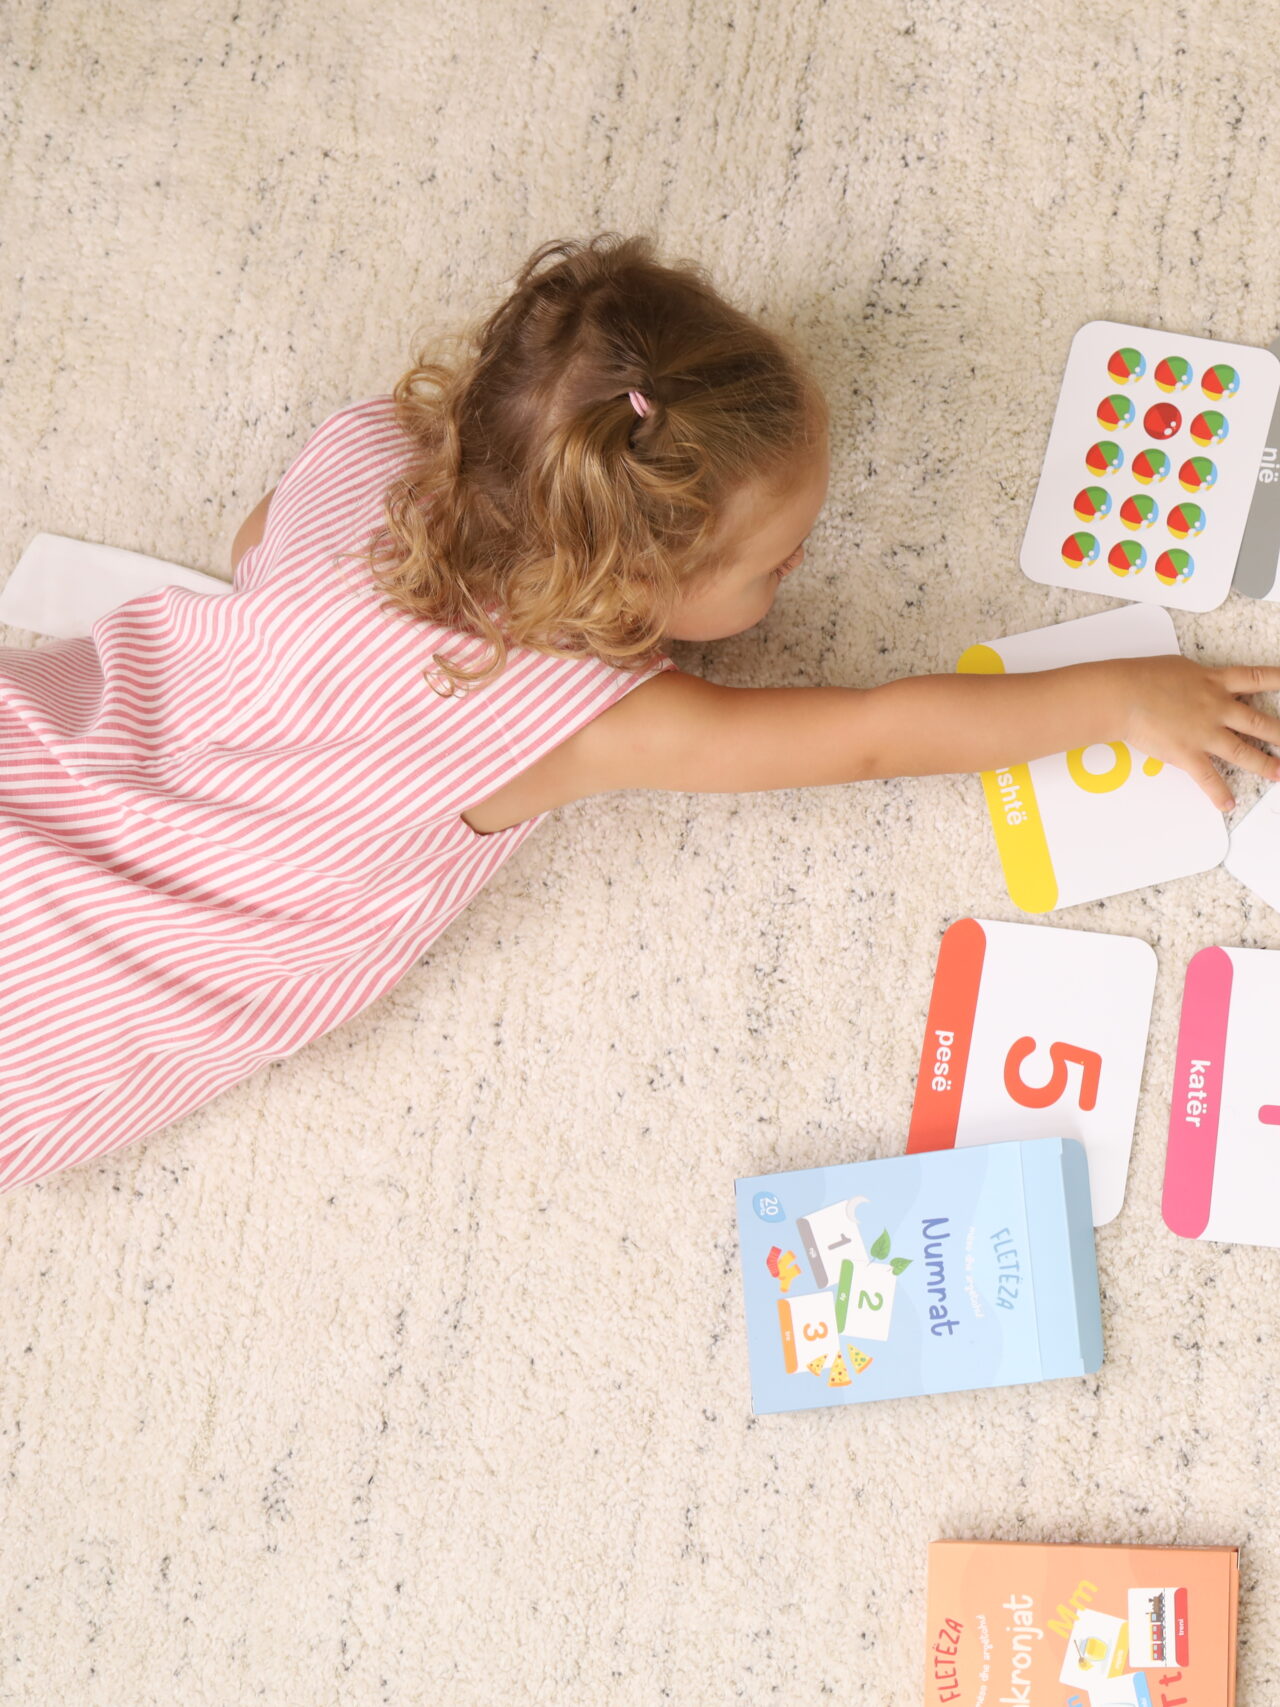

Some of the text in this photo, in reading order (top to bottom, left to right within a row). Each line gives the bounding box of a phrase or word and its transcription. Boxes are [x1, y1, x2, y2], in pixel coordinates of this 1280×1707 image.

[995, 766, 1028, 826] shtë
[930, 1029, 955, 1092] pesë
[1003, 1035, 1103, 1112] 5
[1184, 1059, 1211, 1128] katër
[766, 1197, 779, 1216] 20
[827, 1233, 852, 1251] 1
[990, 1227, 1023, 1310] FLETËZA
[857, 1290, 884, 1311] 2
[921, 1217, 960, 1337] Numrat
[802, 1321, 829, 1342] 3
[1047, 1580, 1100, 1640] Mm
[932, 1617, 964, 1703] FLETËZA
[999, 1593, 1044, 1707] kronjat
